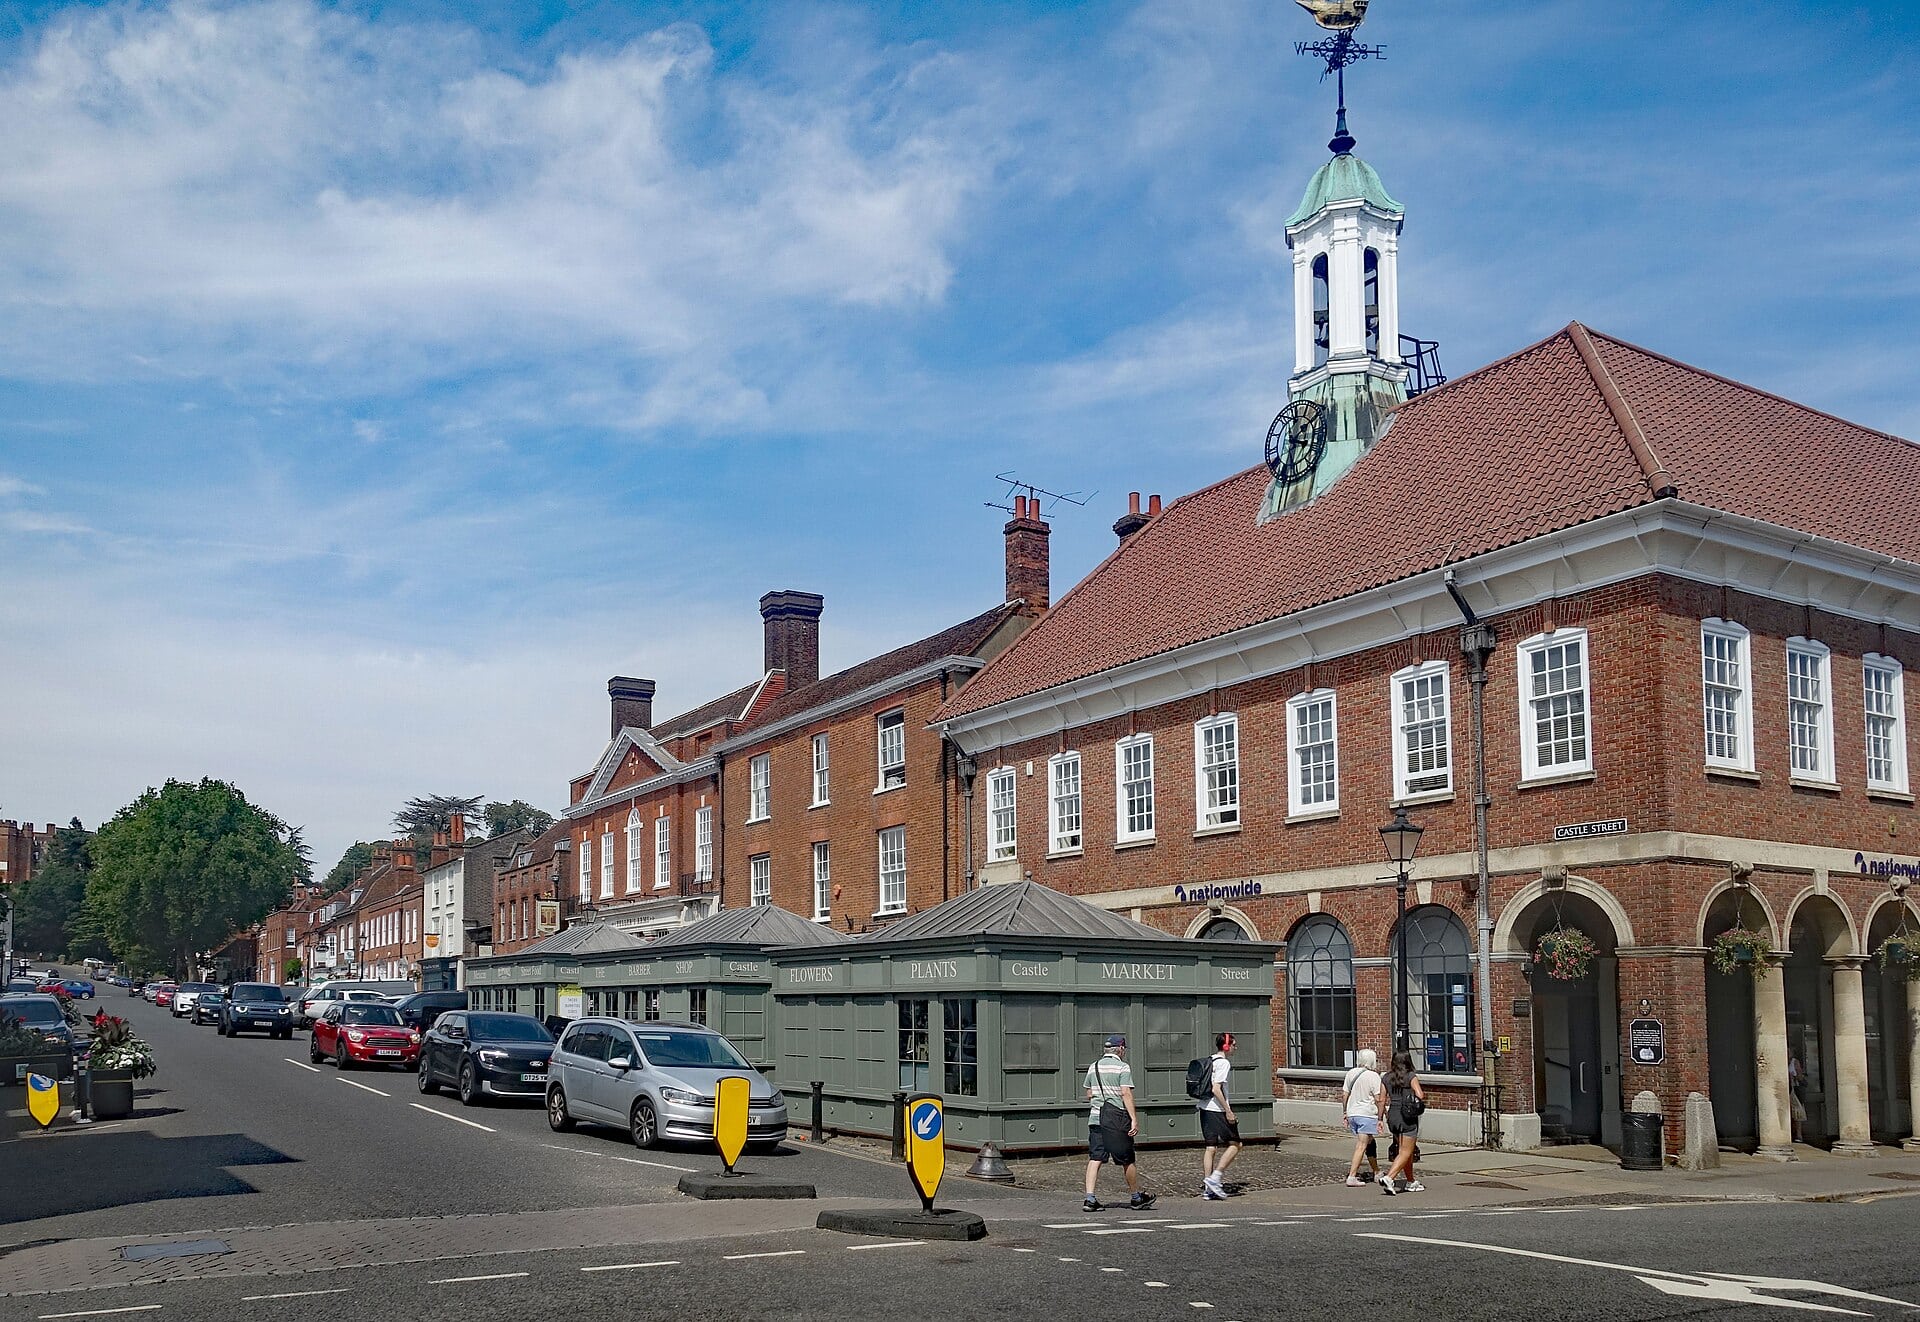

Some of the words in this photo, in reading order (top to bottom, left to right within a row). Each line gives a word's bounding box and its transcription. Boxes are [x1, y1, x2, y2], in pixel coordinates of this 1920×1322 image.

[1294, 42, 1307, 56] W
[1375, 45, 1388, 60] E
[1557, 826, 1588, 837] CASTLE
[1591, 821, 1623, 832] STREET
[1189, 879, 1262, 901] nationwide
[595, 967, 605, 978] THE
[628, 964, 651, 977] BARBER
[675, 961, 693, 974] SHOP
[729, 961, 759, 972] Castle
[790, 967, 833, 983] FLOWERS
[910, 961, 957, 979] PLANTS
[1012, 962, 1049, 977] Castle
[1101, 963, 1176, 980] MARKET
[1220, 967, 1250, 980] Street
[1500, 1038, 1509, 1050] H
